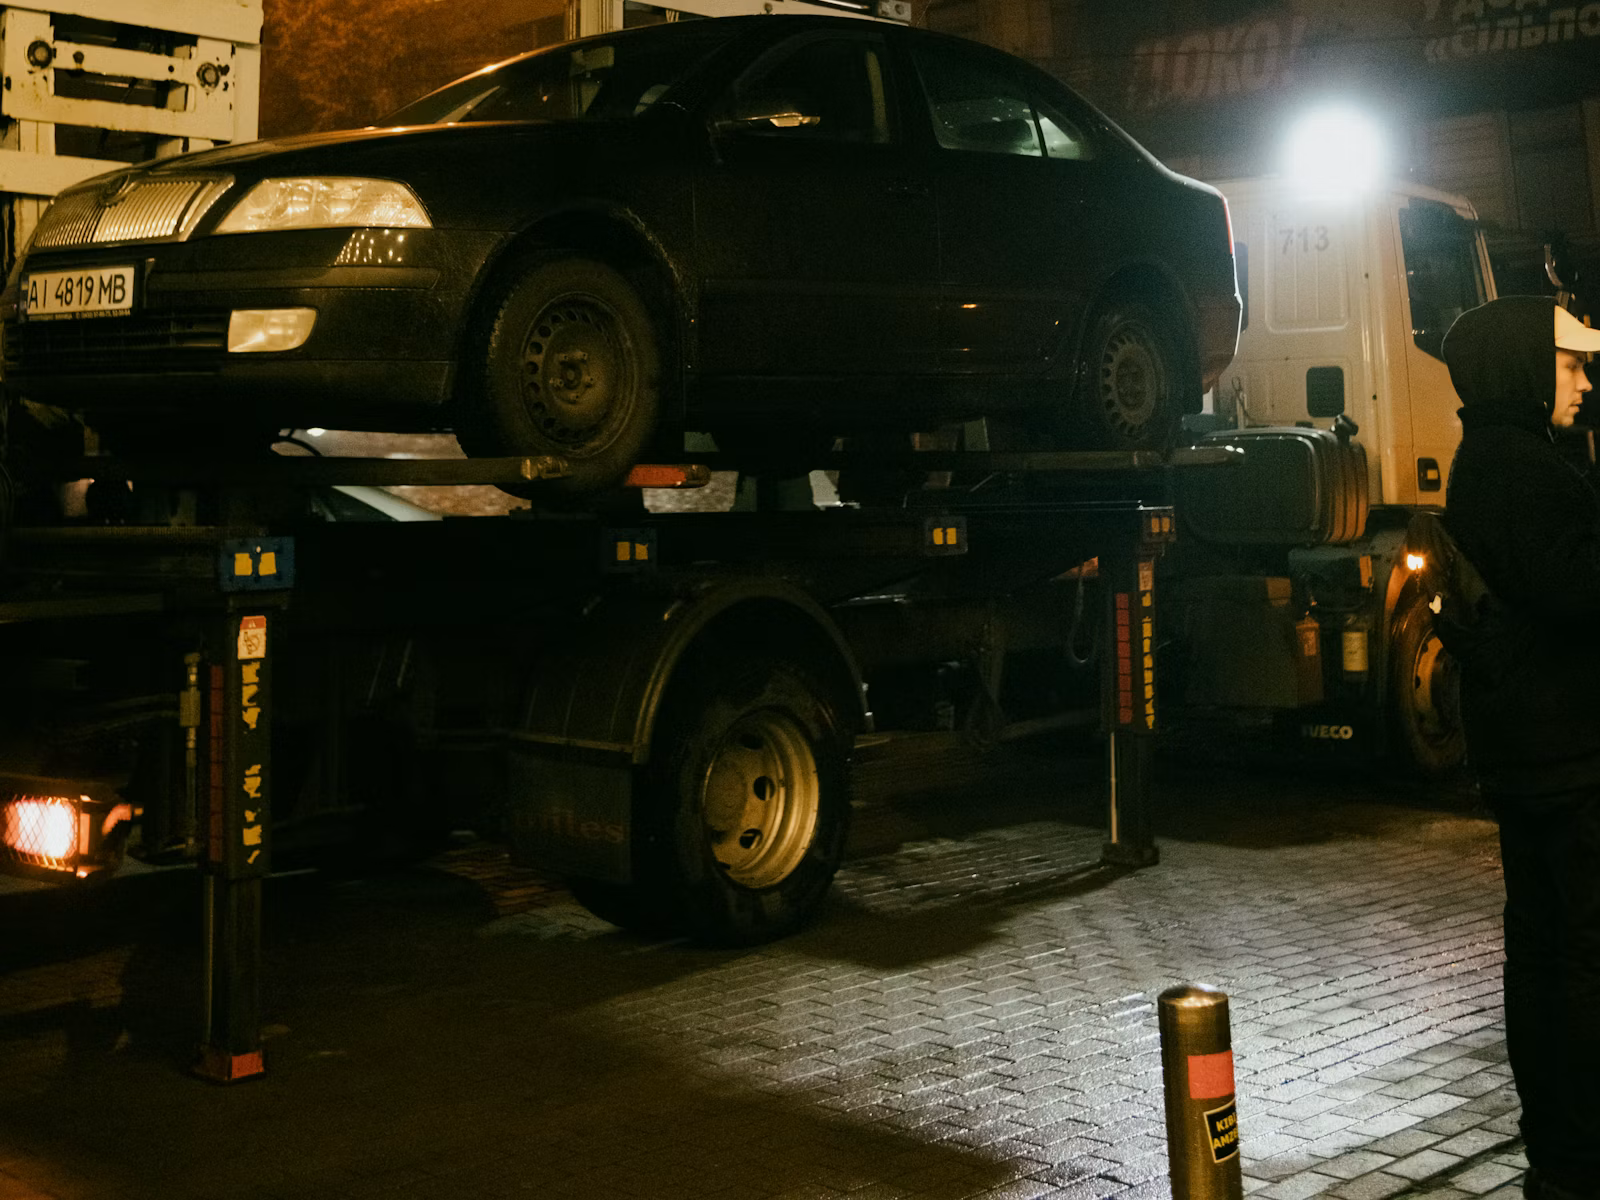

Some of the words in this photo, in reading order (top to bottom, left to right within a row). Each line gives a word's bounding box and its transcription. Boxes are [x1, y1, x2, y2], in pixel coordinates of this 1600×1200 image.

[1279, 225, 1330, 255] 713
[28, 279, 48, 309] AI
[55, 276, 94, 307] 4819
[98, 274, 126, 305] MB
